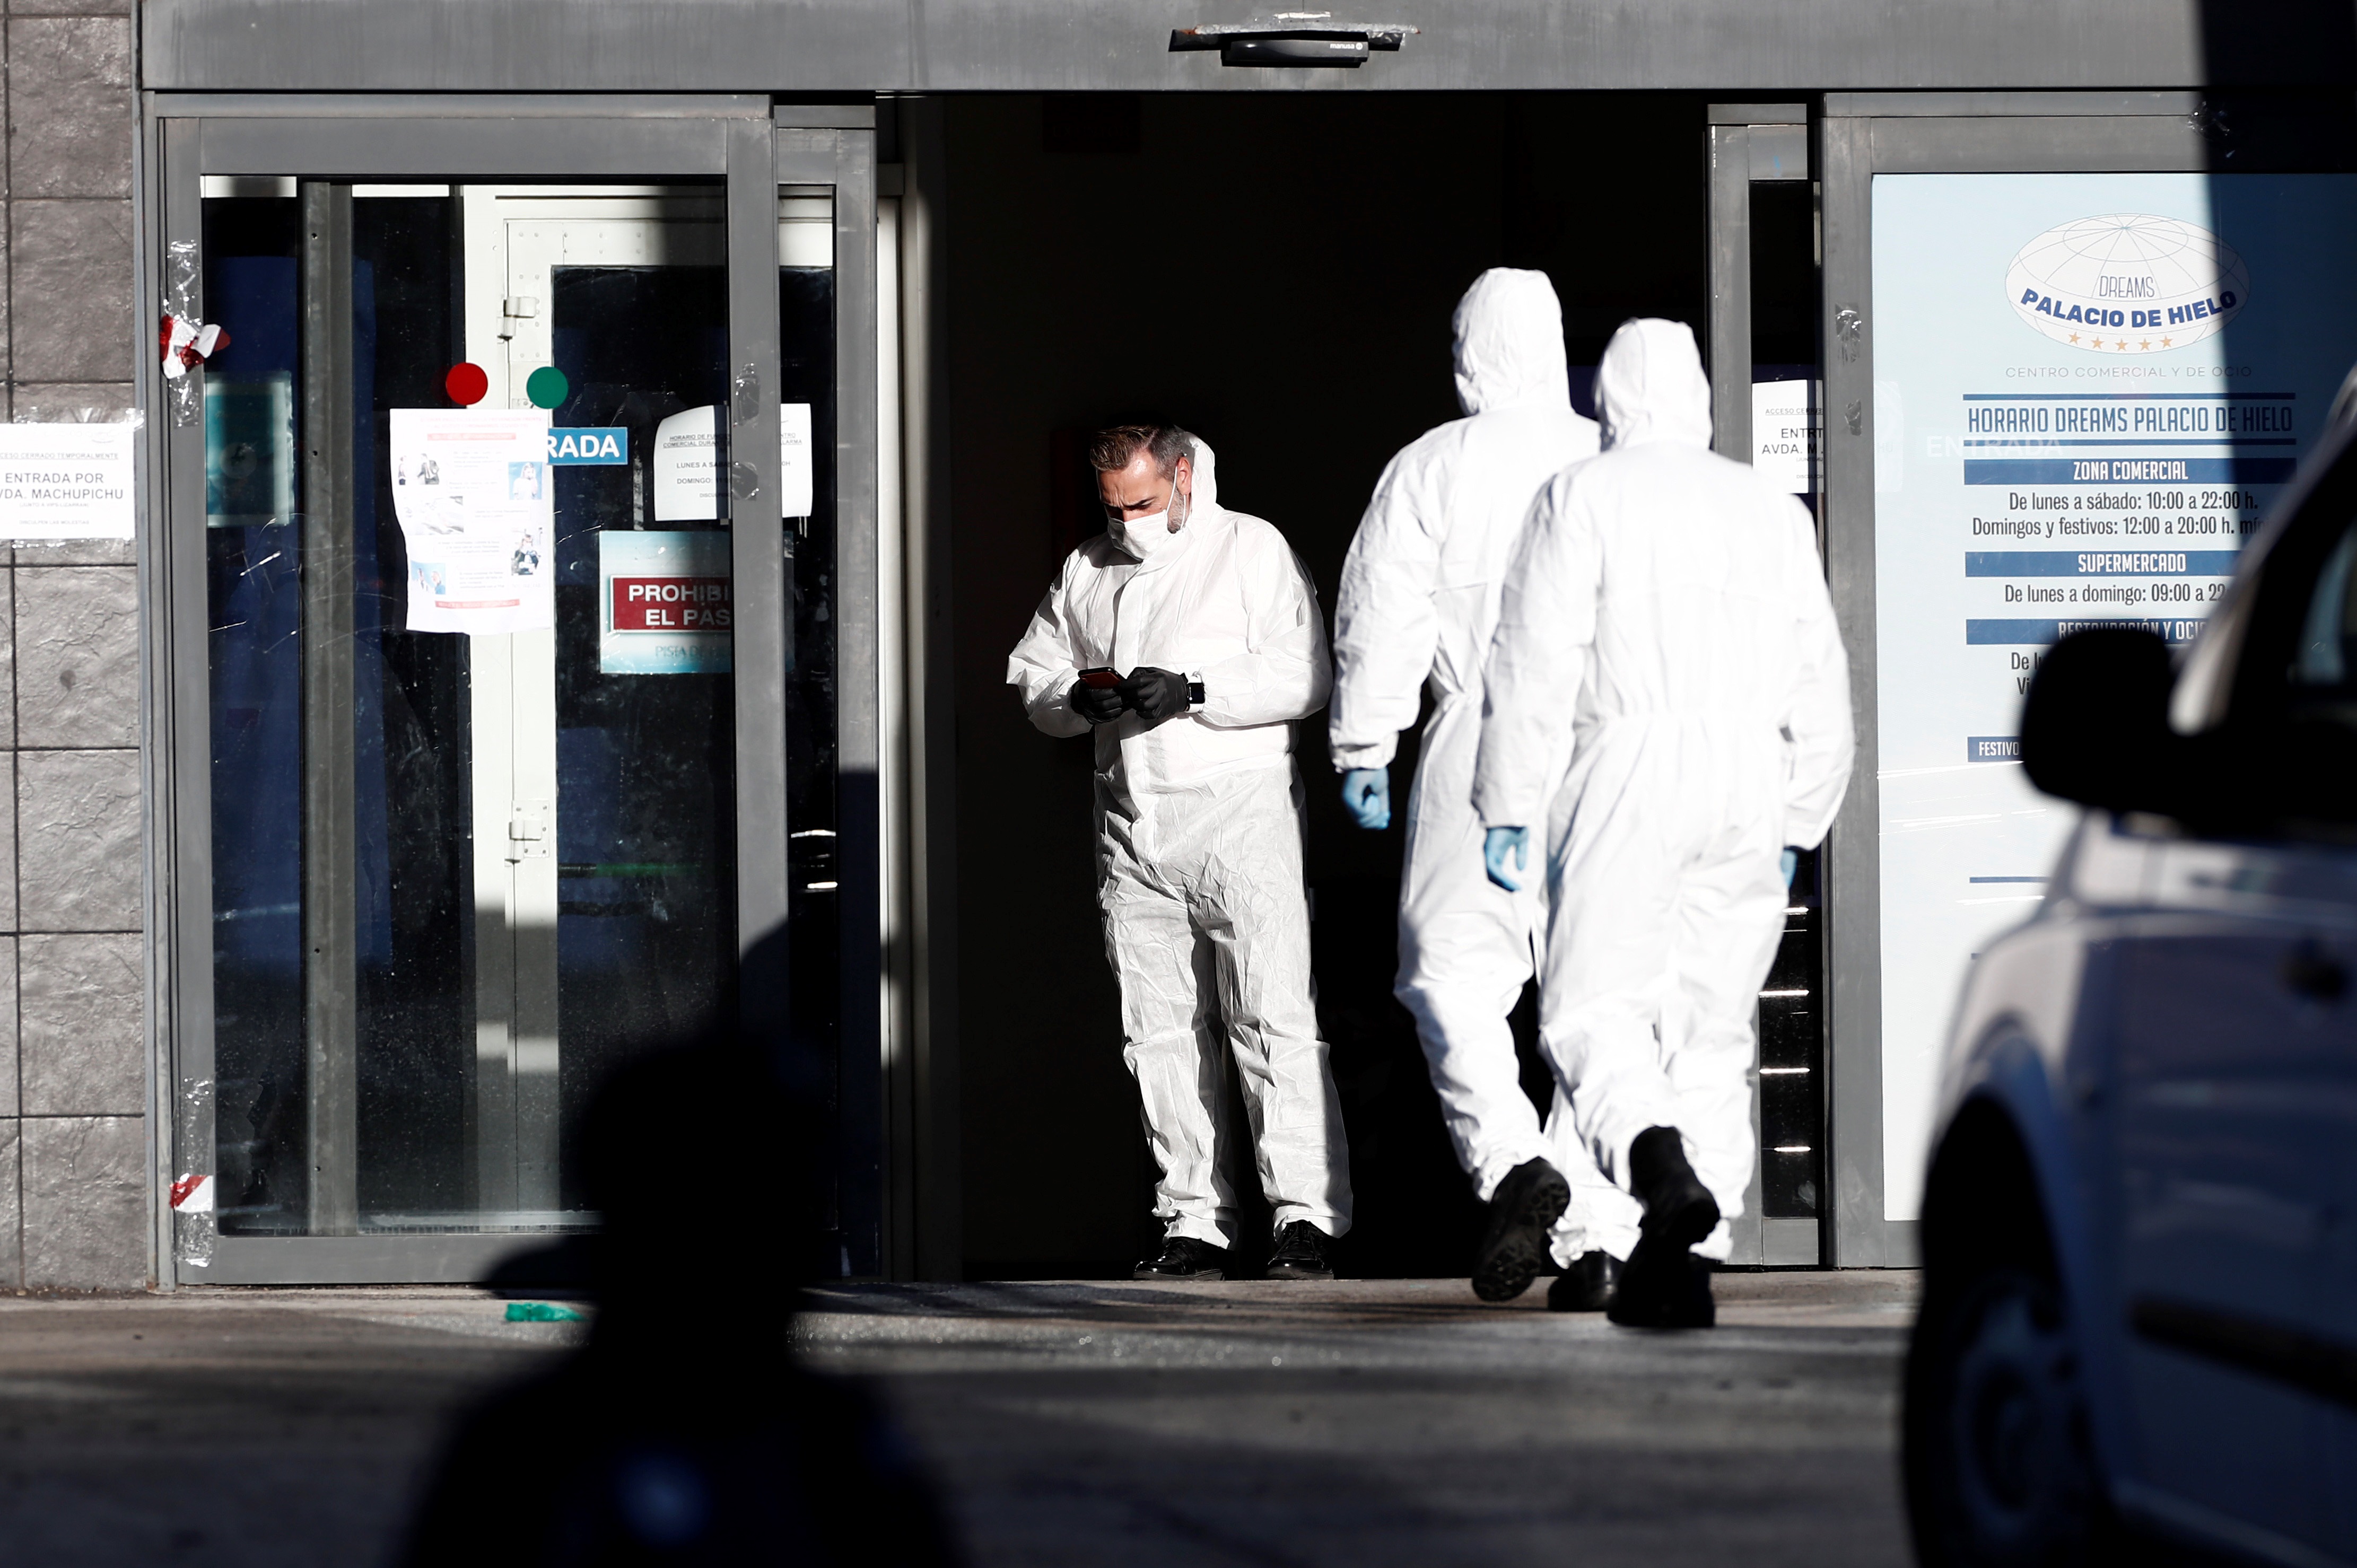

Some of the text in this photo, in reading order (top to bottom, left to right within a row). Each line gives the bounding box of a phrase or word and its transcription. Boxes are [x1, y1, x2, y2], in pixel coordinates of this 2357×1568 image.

[2099, 276, 2155, 298] DREAMS
[2020, 288, 2237, 328] PALACIO DE HIELO
[2005, 366, 2252, 378] CENTRO COMERCIAL Y DE OCIO
[1968, 406, 2292, 433] HORARIO DREAMS PALACIO DE HIELO
[547, 435, 620, 458] RADA
[1762, 444, 1803, 454] AVDA.
[5, 473, 103, 483] ENTRADA POR
[2073, 460, 2188, 481] ZONA COMERCIAL
[32, 489, 123, 499] MACHUPICHU
[2009, 491, 2258, 510] De lunes a sábado: 10:00 a 22:00 h.
[1972, 518, 2041, 539] Domingos
[2046, 523, 2054, 539] y
[2058, 516, 2118, 536] festivos:
[2123, 517, 2159, 536] 12:00
[2164, 522, 2173, 535] a
[2177, 517, 2216, 535] 20:00
[2221, 516, 2235, 535] h.
[2078, 553, 2187, 573] SUPERMERCADO
[2005, 585, 2023, 602] De
[2028, 584, 2064, 602] lunes
[2069, 590, 2077, 602] a
[2082, 584, 2146, 606] domingo:
[2151, 584, 2190, 602] 09:00
[2195, 589, 2204, 602] a
[645, 609, 730, 626] EL PAS
[2162, 622, 2172, 640] Y
[2011, 653, 2029, 670] De
